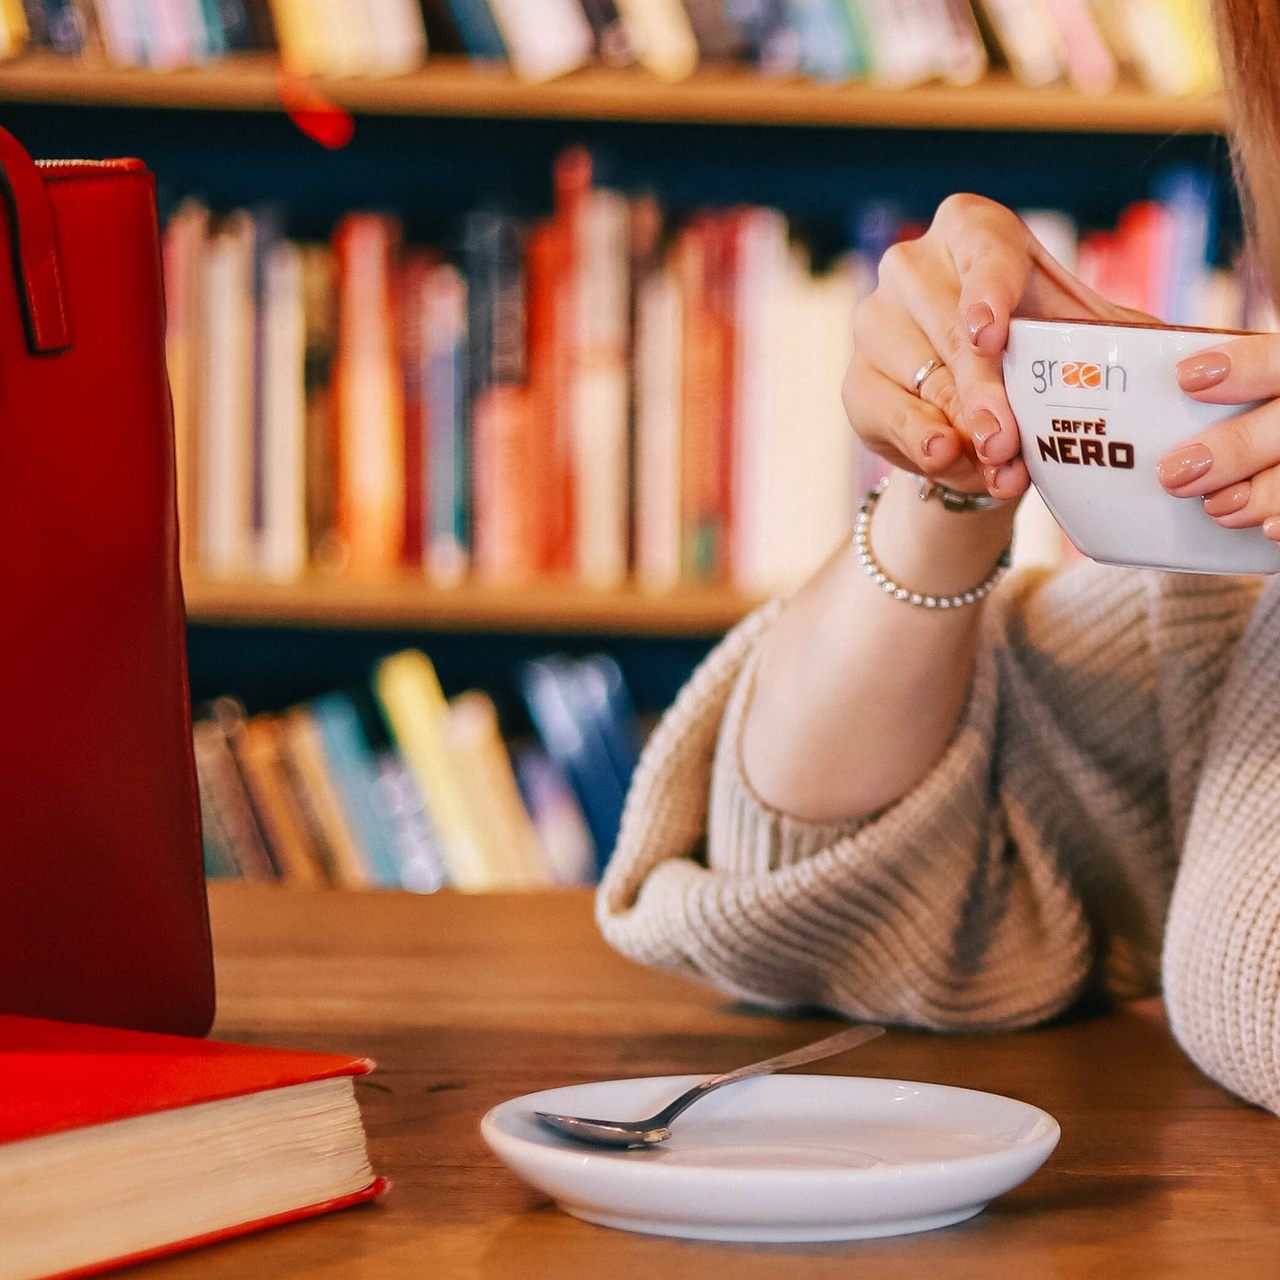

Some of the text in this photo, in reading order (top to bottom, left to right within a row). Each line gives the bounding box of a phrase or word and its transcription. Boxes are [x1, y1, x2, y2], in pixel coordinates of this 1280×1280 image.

[1031, 359, 1127, 394] green
[1051, 417, 1107, 436] CAFFÈ
[1036, 435, 1135, 470] NERO
